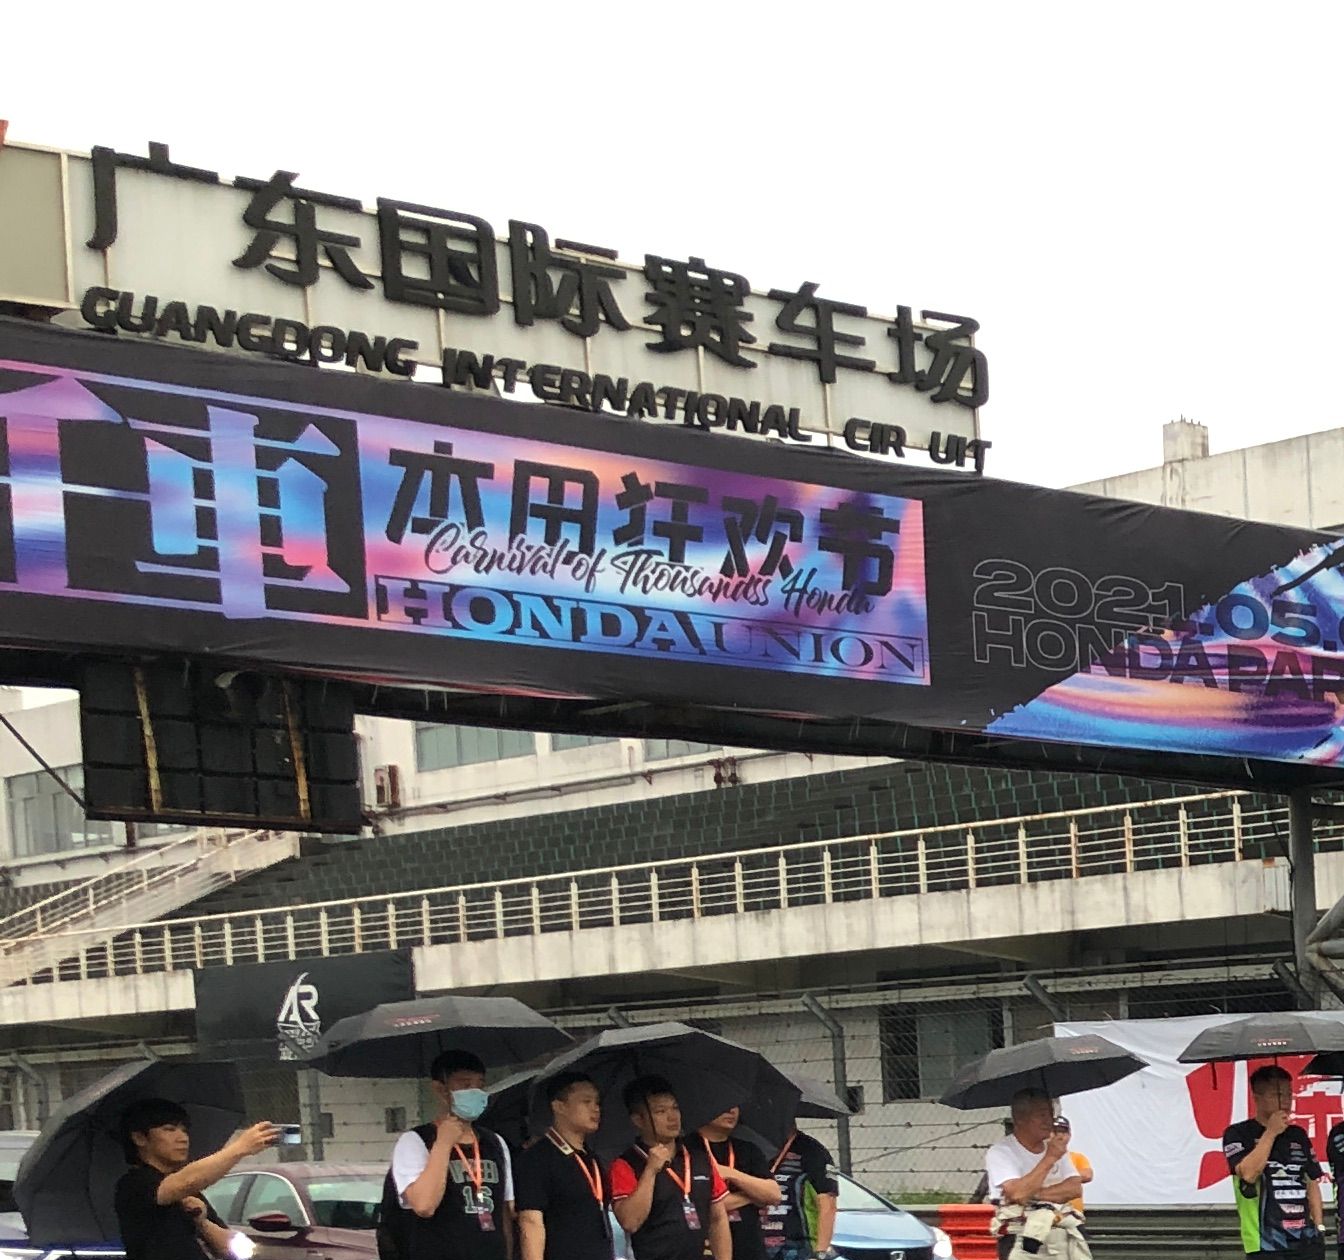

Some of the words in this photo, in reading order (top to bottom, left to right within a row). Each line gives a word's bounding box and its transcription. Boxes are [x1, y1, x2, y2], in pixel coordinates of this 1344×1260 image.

[86, 141, 989, 408] 广东国际赛车场
[80, 286, 419, 376] GUANGDONG
[441, 347, 813, 442] INTERNATIONAL
[385, 440, 901, 597] 本田狂欢节
[781, 567, 875, 618] Honda
[973, 611, 1219, 688] HONDA
